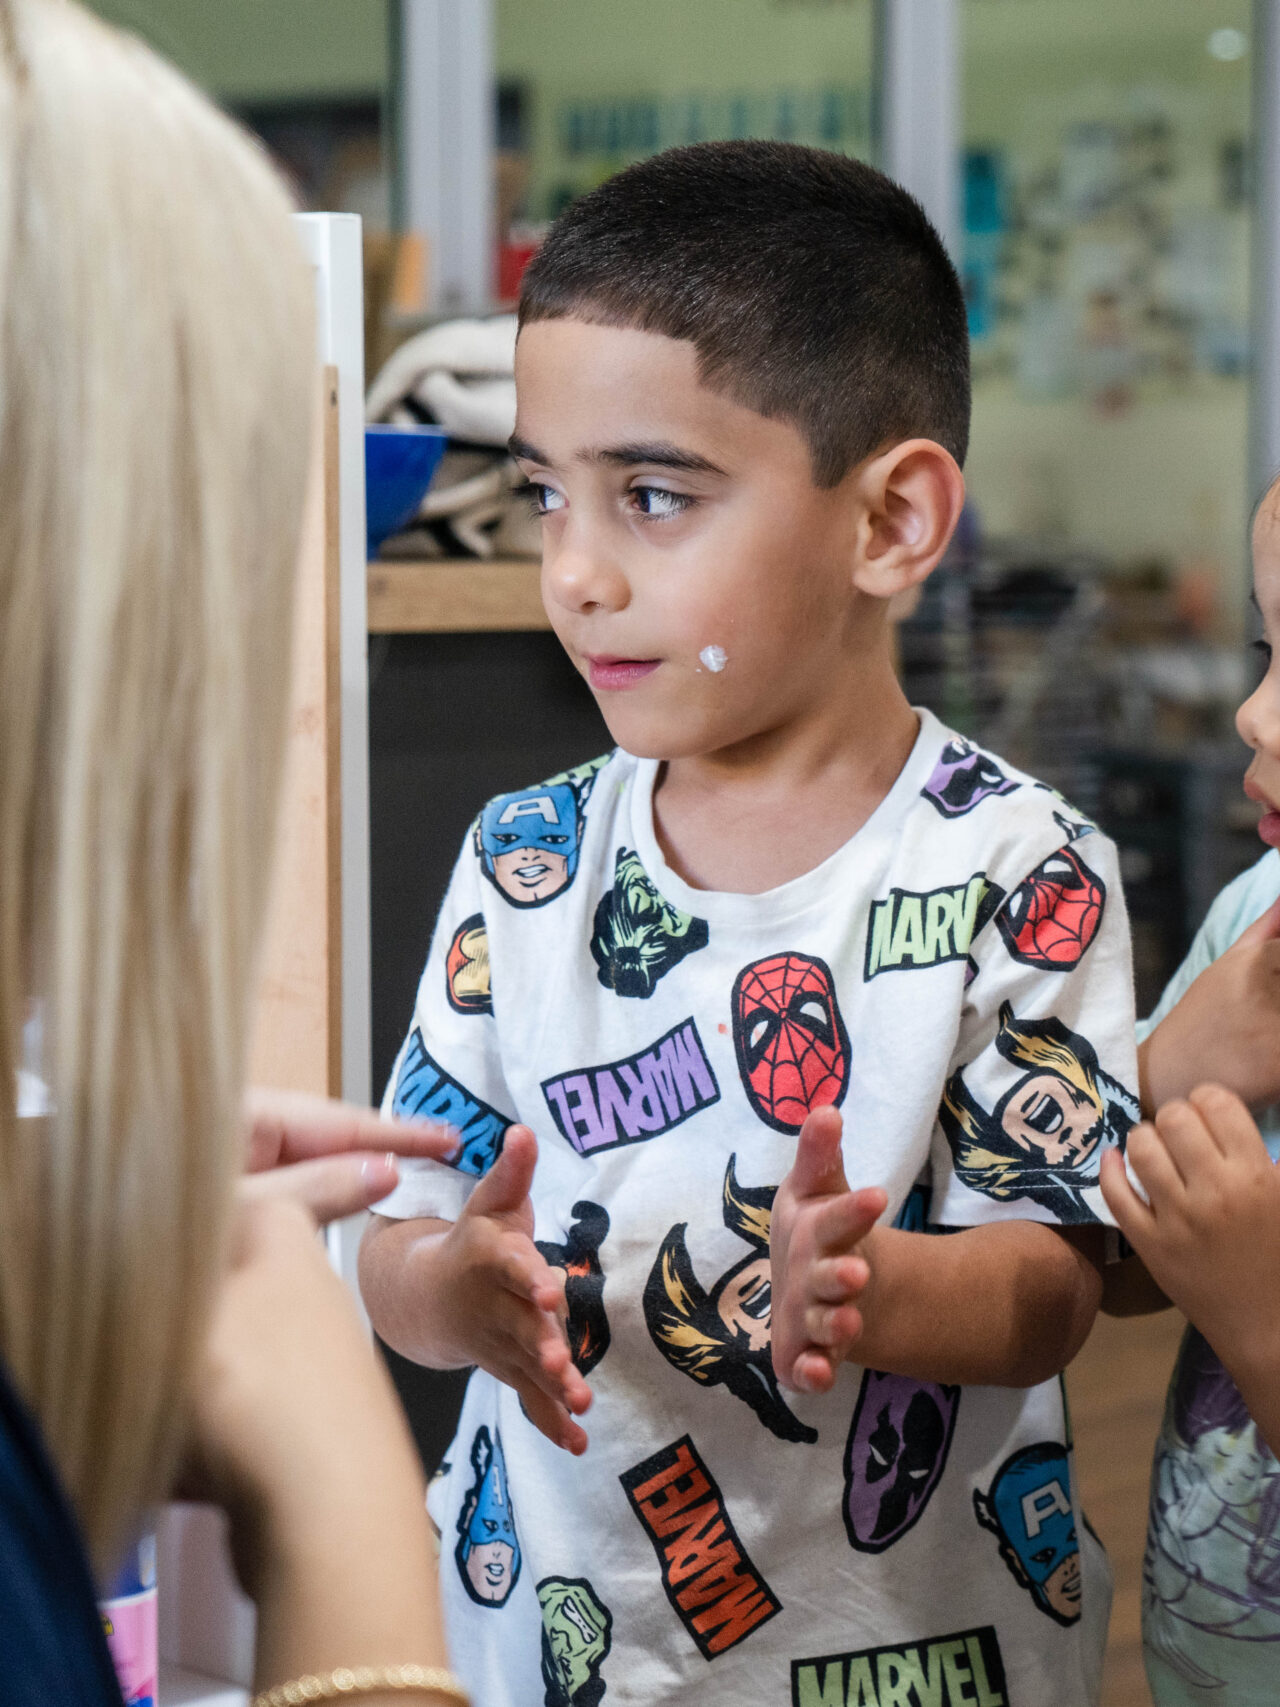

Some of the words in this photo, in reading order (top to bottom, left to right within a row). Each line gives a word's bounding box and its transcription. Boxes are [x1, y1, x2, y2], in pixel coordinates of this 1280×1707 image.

[498, 796, 559, 824] A
[868, 876, 990, 976] MARV
[546, 1025, 716, 1153] MARVEL
[633, 1444, 775, 1654] MARVEL
[1021, 1479, 1071, 1539] A
[797, 1635, 1003, 1707] MARVEL
